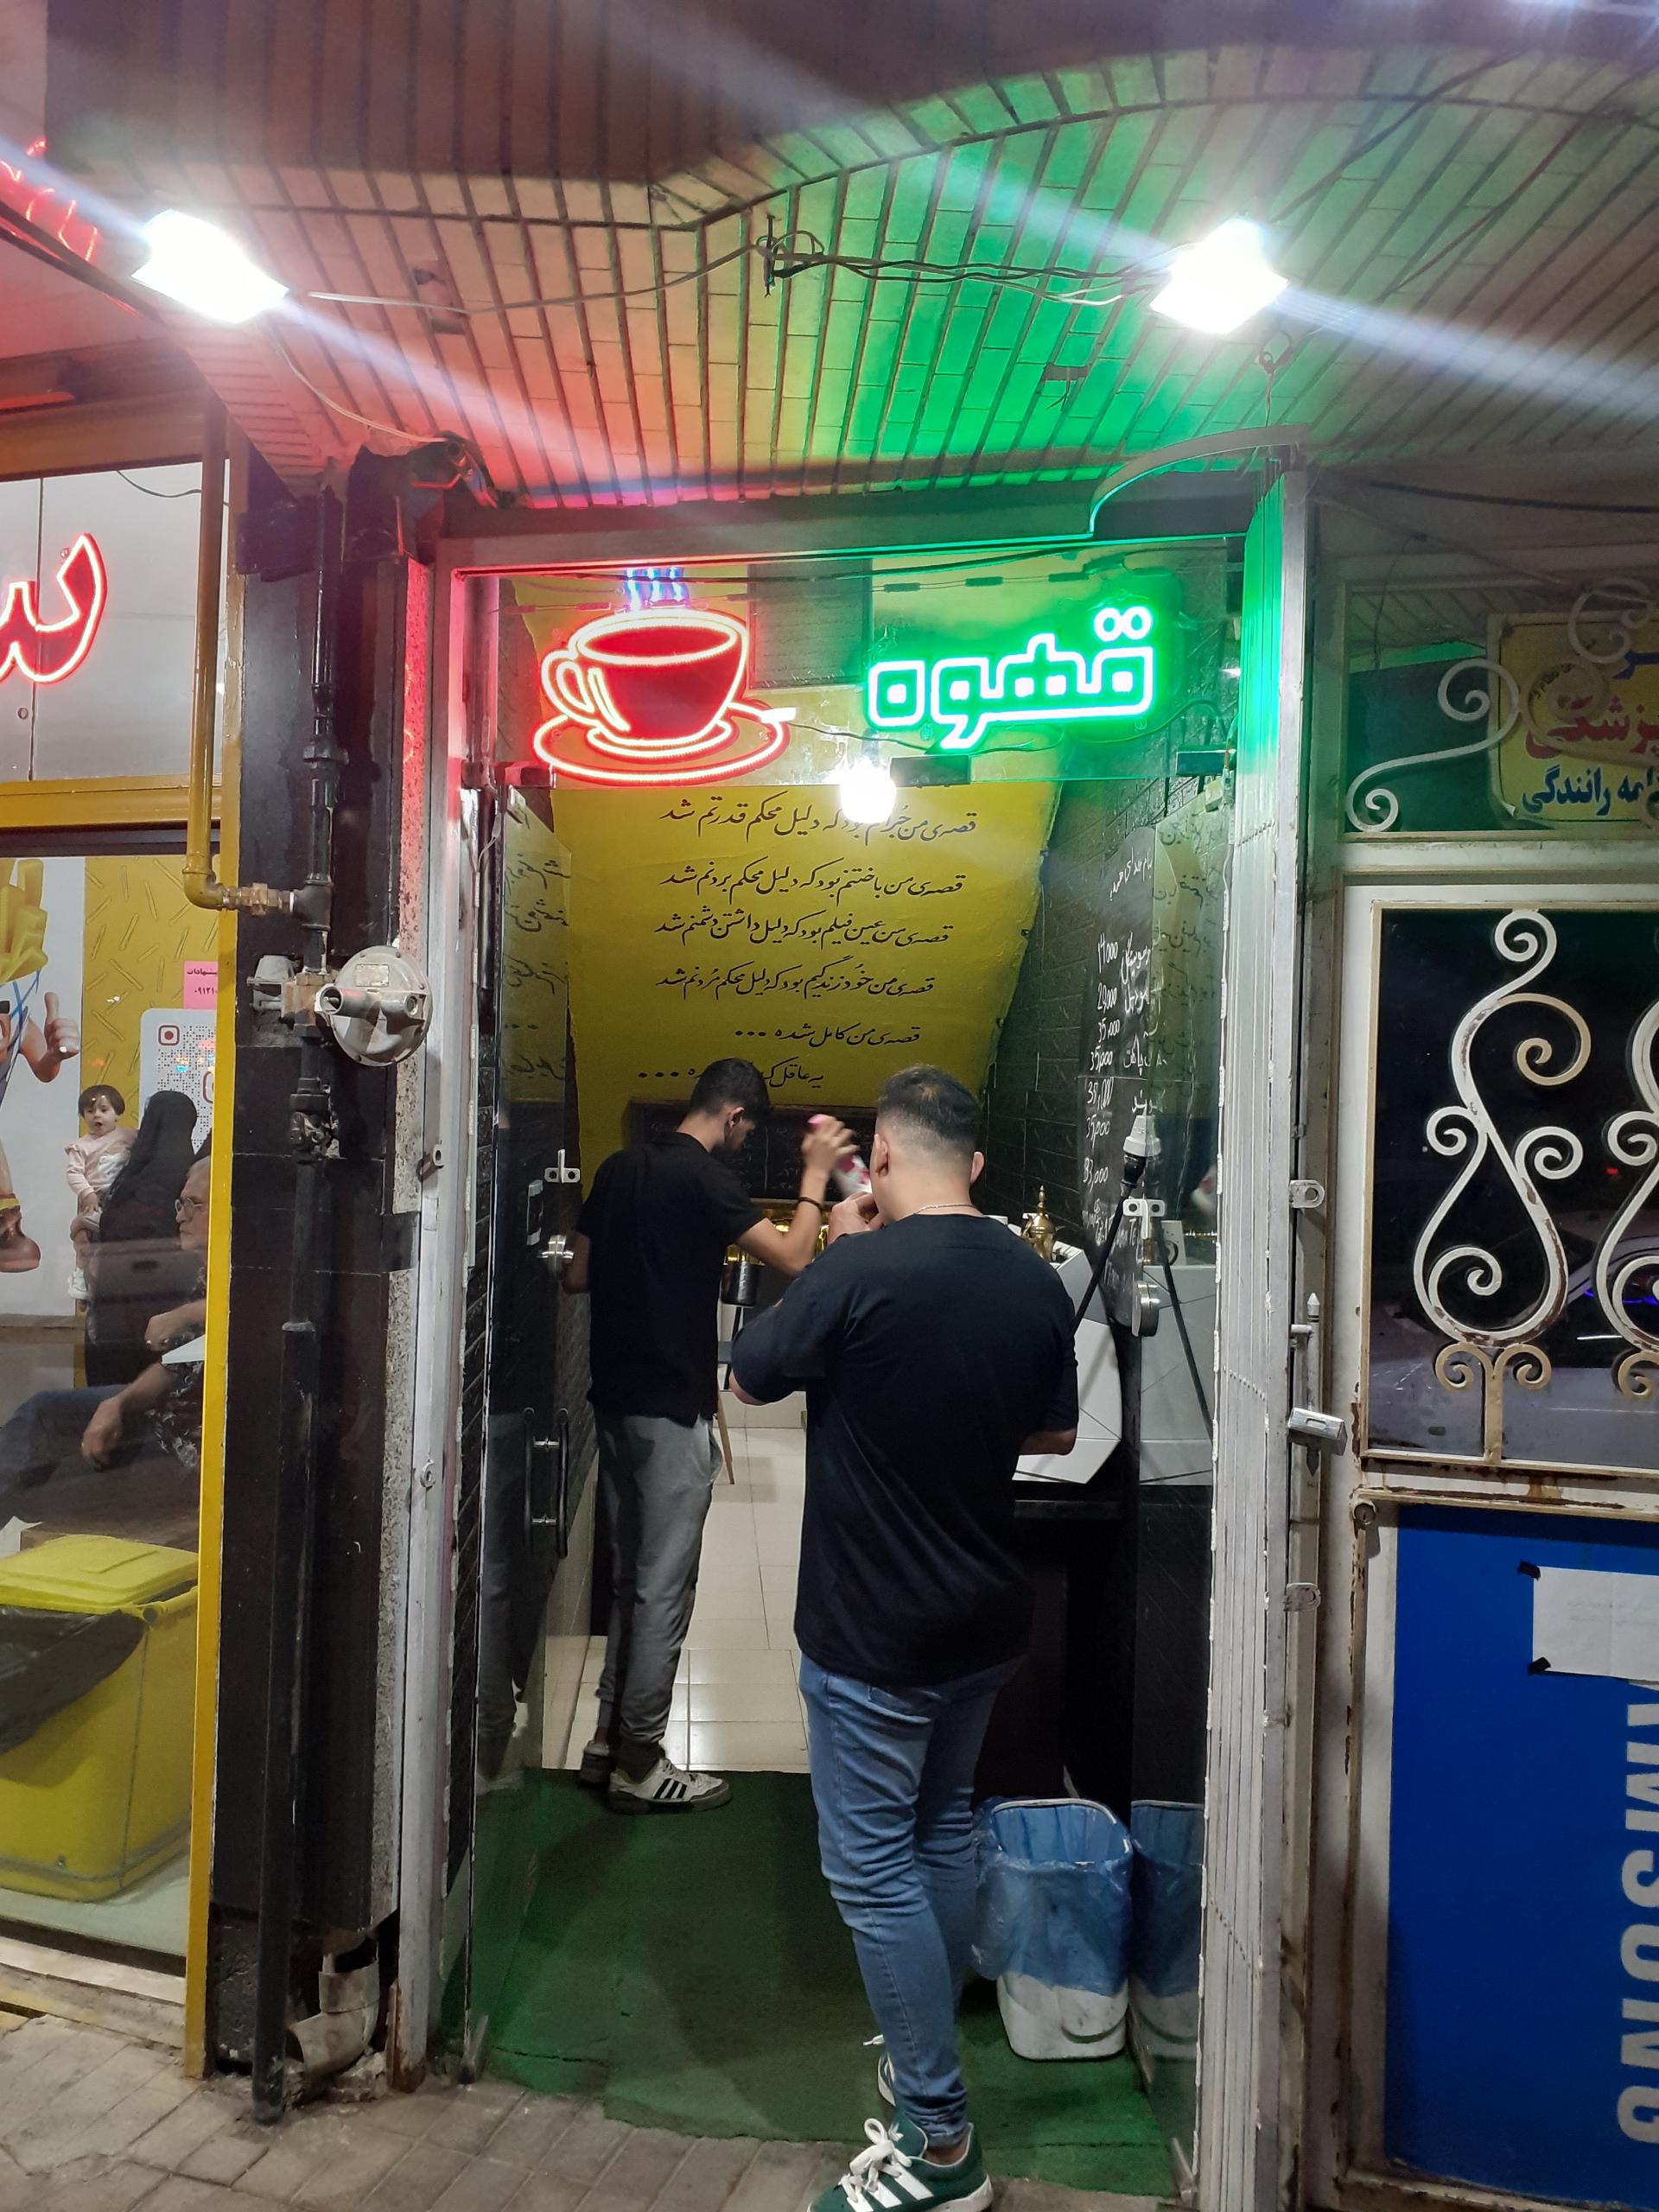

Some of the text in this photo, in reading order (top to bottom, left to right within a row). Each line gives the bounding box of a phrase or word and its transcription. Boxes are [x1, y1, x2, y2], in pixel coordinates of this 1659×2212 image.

[868, 605, 1154, 750] قهوه
[1522, 763, 1611, 817] رانندگی
[658, 798, 696, 820] شد
[697, 795, 749, 838] قدرتم
[746, 790, 789, 843] محکم
[773, 804, 821, 836] دلیل
[658, 865, 698, 885] شد
[696, 861, 733, 896] بردنم
[728, 855, 769, 906] محکم
[755, 866, 798, 895] دلیل
[815, 877, 841, 898] بود
[653, 912, 686, 933] شد
[709, 908, 760, 939] داشتن
[749, 917, 789, 944] دلیل
[798, 927, 822, 944] بود
[820, 912, 854, 950] فیلم
[843, 920, 886, 945] عین
[655, 968, 688, 987] شد
[715, 960, 755, 1001] محکم
[735, 968, 770, 996] دلیل
[779, 978, 804, 993] بود
